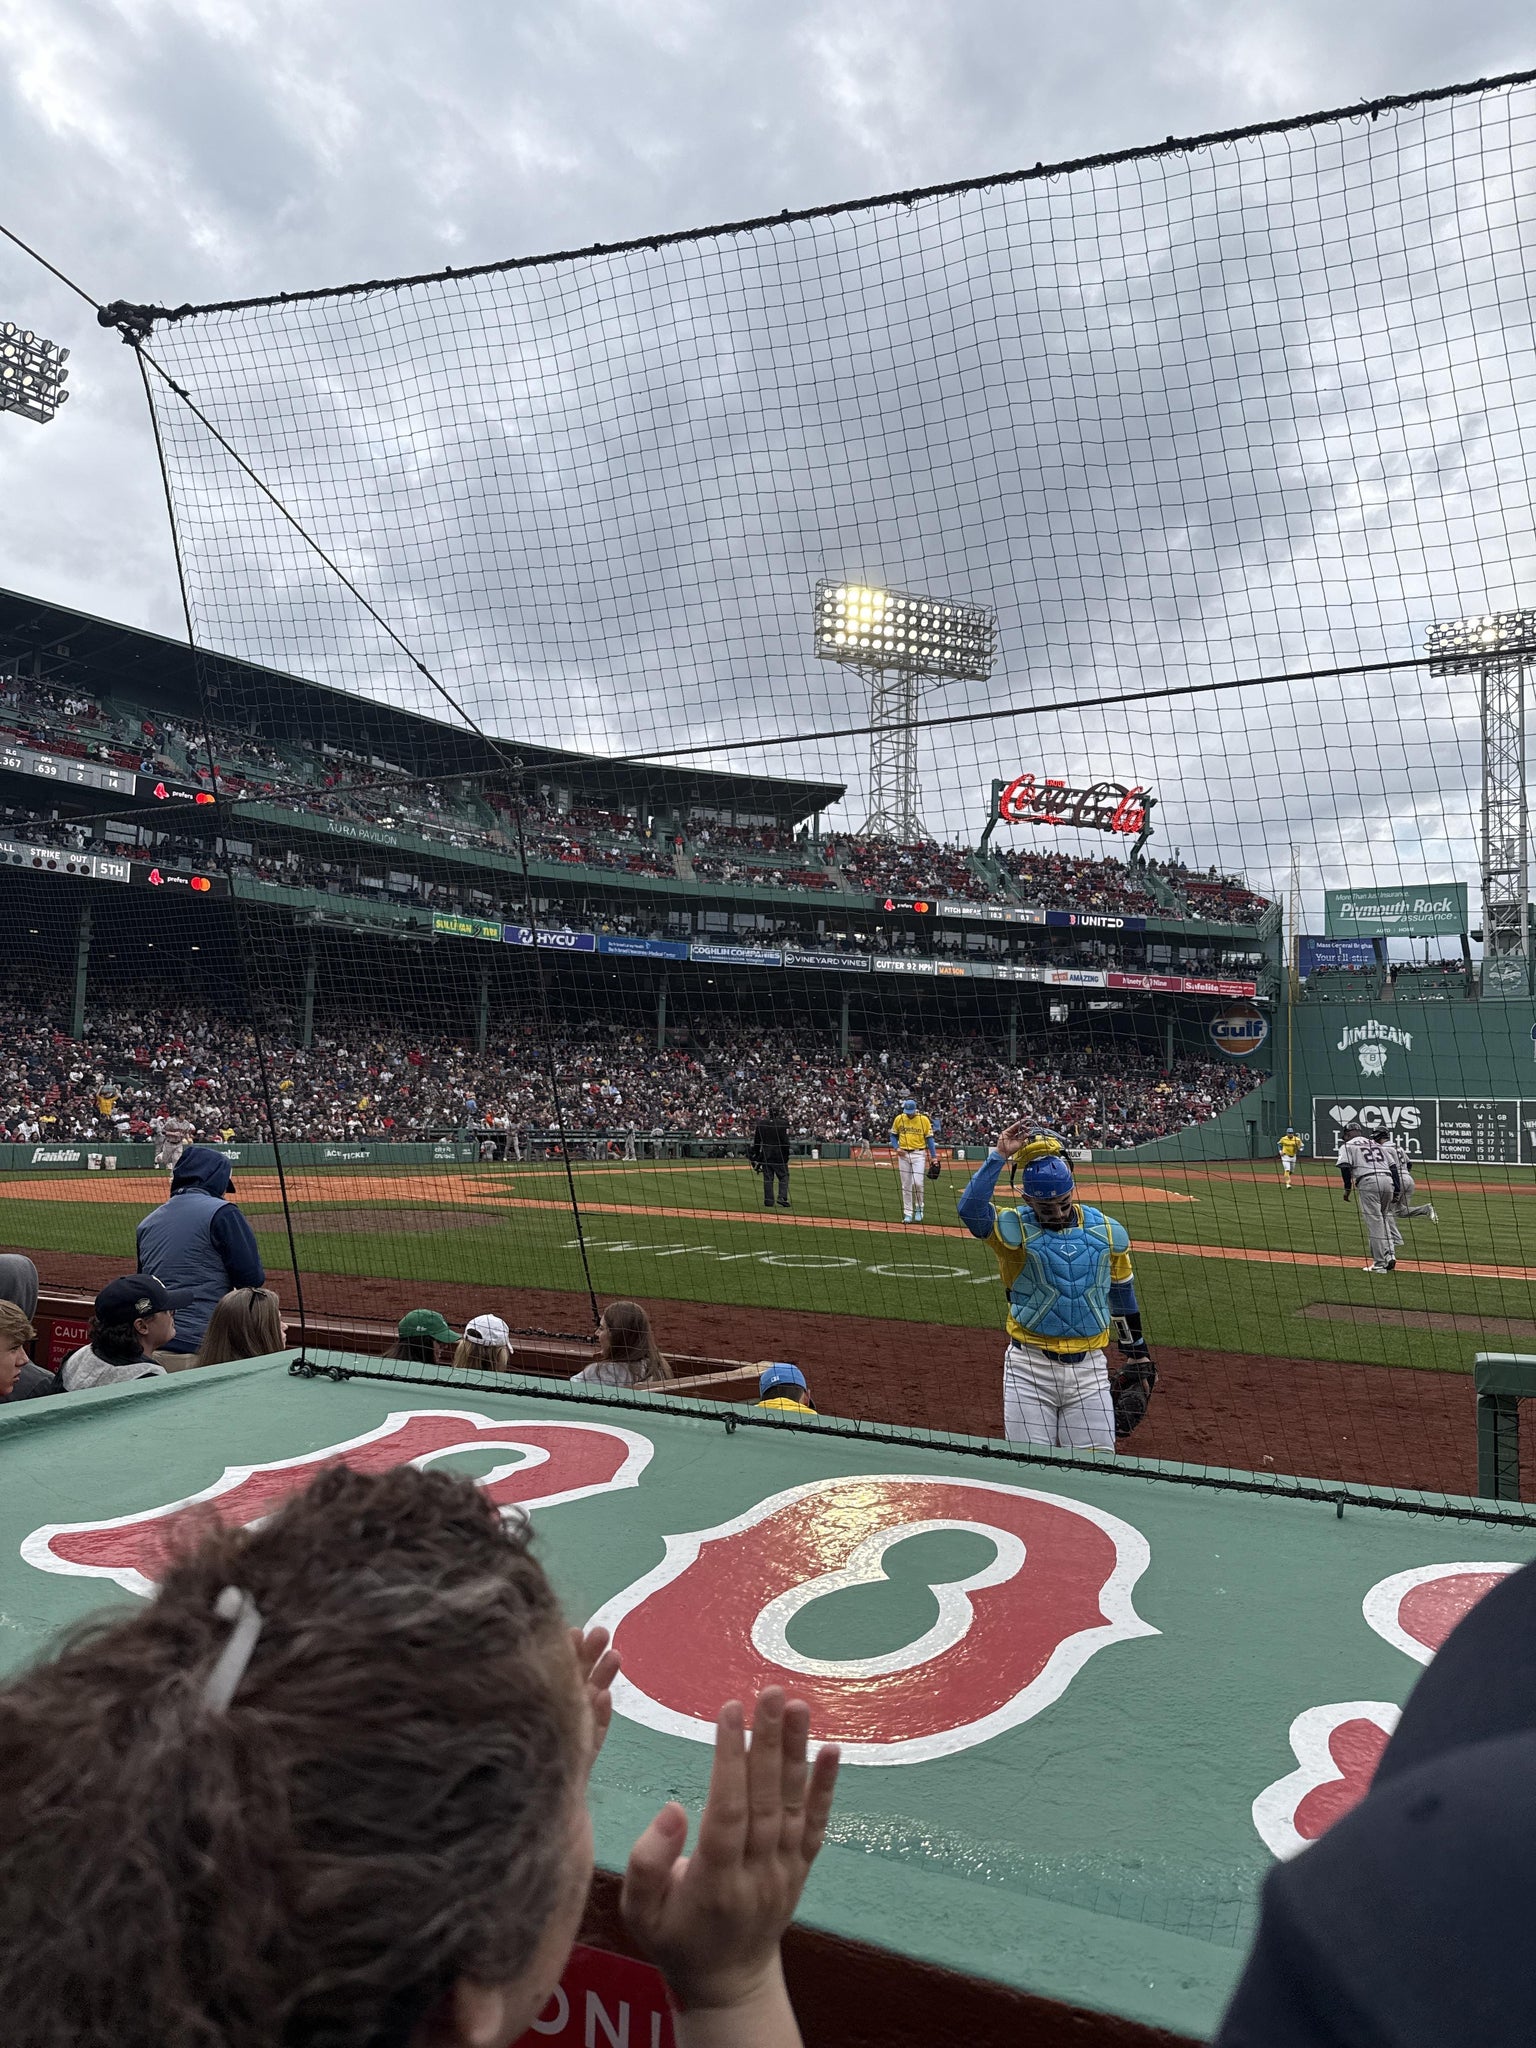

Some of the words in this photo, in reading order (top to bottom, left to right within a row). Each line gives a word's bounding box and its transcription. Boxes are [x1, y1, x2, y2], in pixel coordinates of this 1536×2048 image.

[34, 764, 57, 775] .639
[77, 773, 84, 781] 2
[108, 779, 118, 788] 14
[172, 791, 194, 799] prefers
[358, 829, 397, 845] PAVILION
[0, 843, 15, 853] ALL
[30, 848, 61, 860] STRIKE
[70, 855, 88, 863] OUT
[100, 863, 124, 877] 5TH
[166, 876, 189, 884] prefers
[1340, 900, 1410, 919] Plymouth
[1413, 897, 1453, 914] Rock
[1081, 916, 1124, 928] UNITED
[537, 932, 577, 946] HYCU
[794, 955, 839, 965] VINEYARD
[841, 959, 868, 967] VINES
[1316, 953, 1335, 962] Your
[876, 960, 904, 970] CUTTER
[1069, 974, 1099, 982] AMAZING
[1185, 982, 1219, 992] Safelite
[1211, 1020, 1264, 1037] Gulf
[1337, 1026, 1367, 1051] JIM
[1367, 1020, 1413, 1051] BEAM
[1359, 1105, 1422, 1129] CVS
[342, 1151, 370, 1160] TICKET
[1361, 1147, 1384, 1162] 23
[54, 1326, 88, 1340] CAUTI
